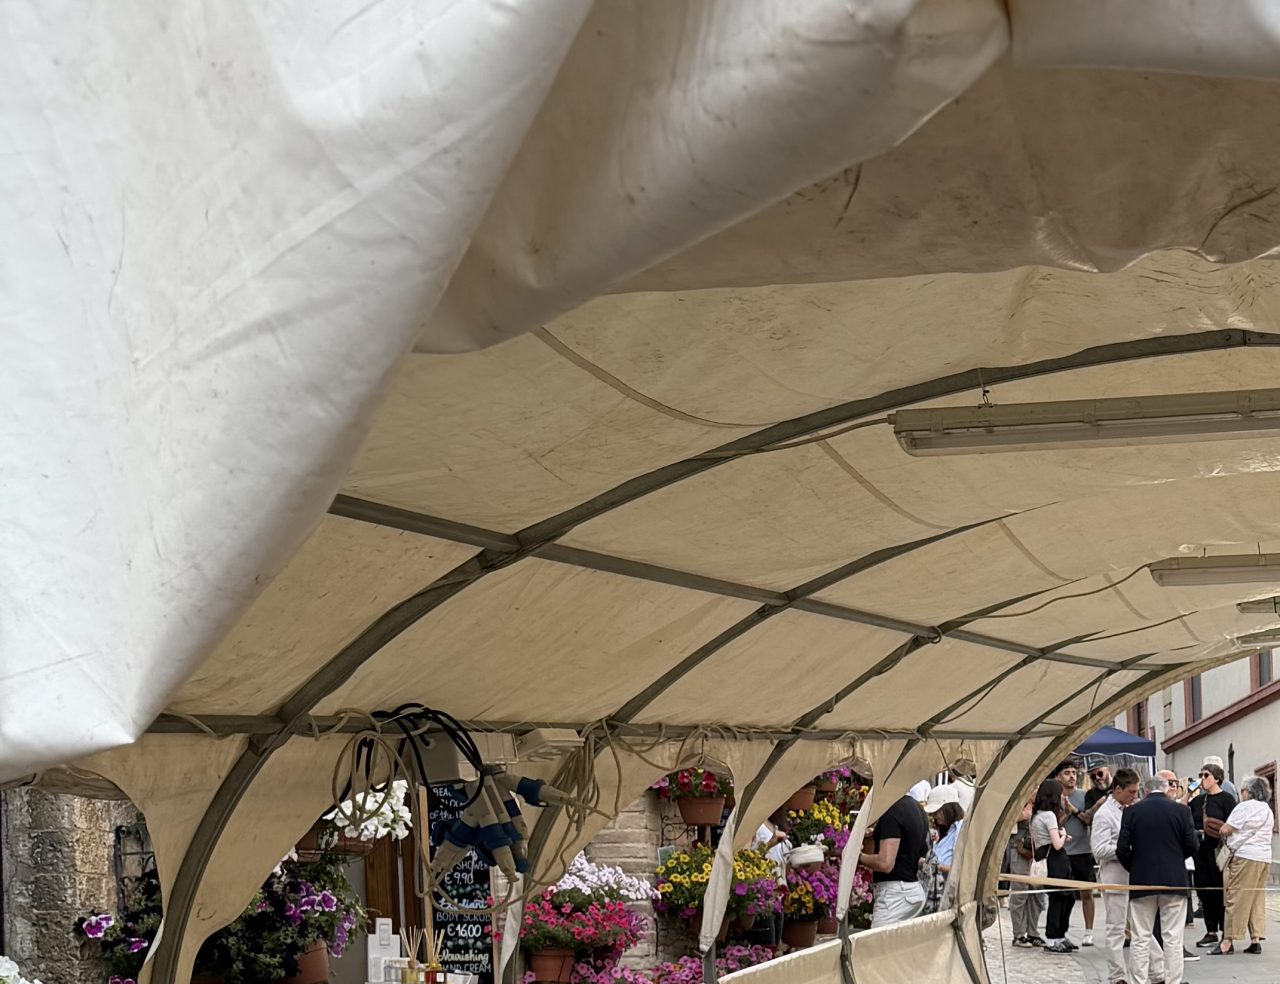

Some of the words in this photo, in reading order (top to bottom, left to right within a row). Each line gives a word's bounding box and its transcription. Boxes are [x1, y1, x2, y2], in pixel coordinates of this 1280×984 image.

[436, 911, 459, 921] BODY
[439, 948, 489, 965] Nourishing
[464, 963, 491, 973] CREAM
